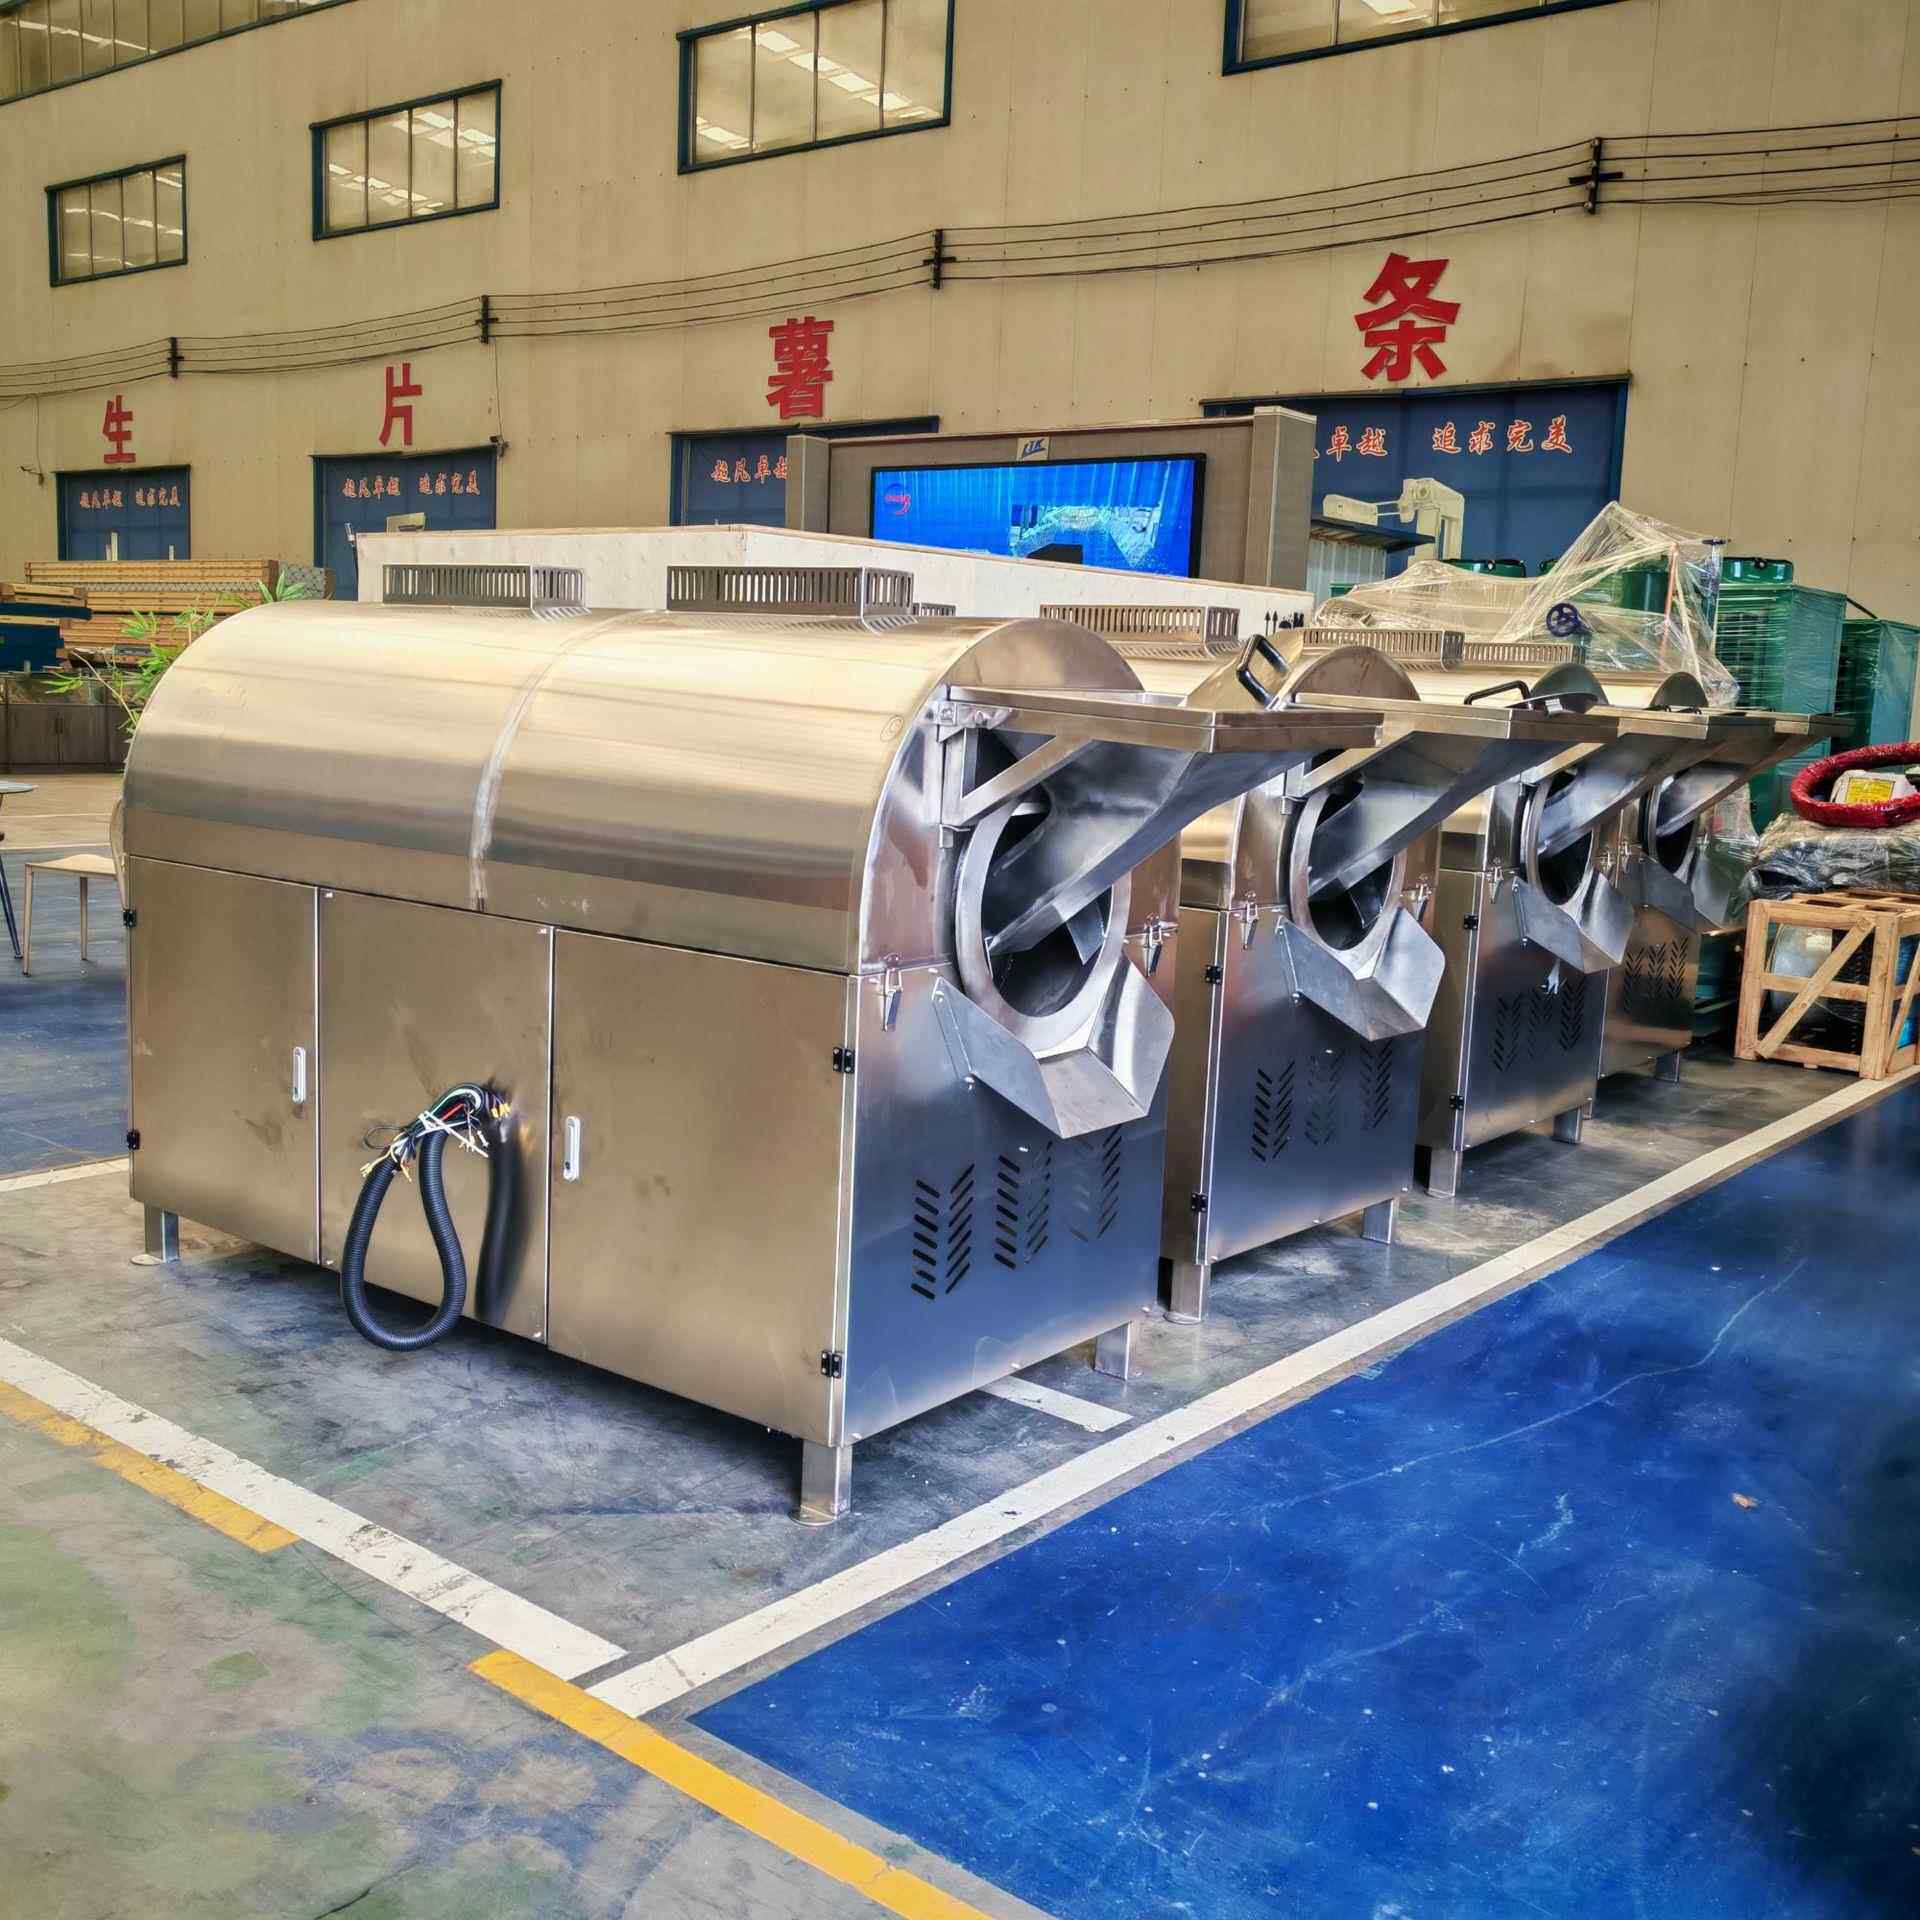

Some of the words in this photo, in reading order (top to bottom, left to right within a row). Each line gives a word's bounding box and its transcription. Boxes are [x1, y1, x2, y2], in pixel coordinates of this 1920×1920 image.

[102, 395, 136, 463] 生
[379, 362, 423, 447] 片
[766, 316, 834, 419] 薯
[1354, 252, 1461, 382] 条
[1312, 425, 1388, 462] 卓越
[1432, 415, 1572, 455] 追求完美
